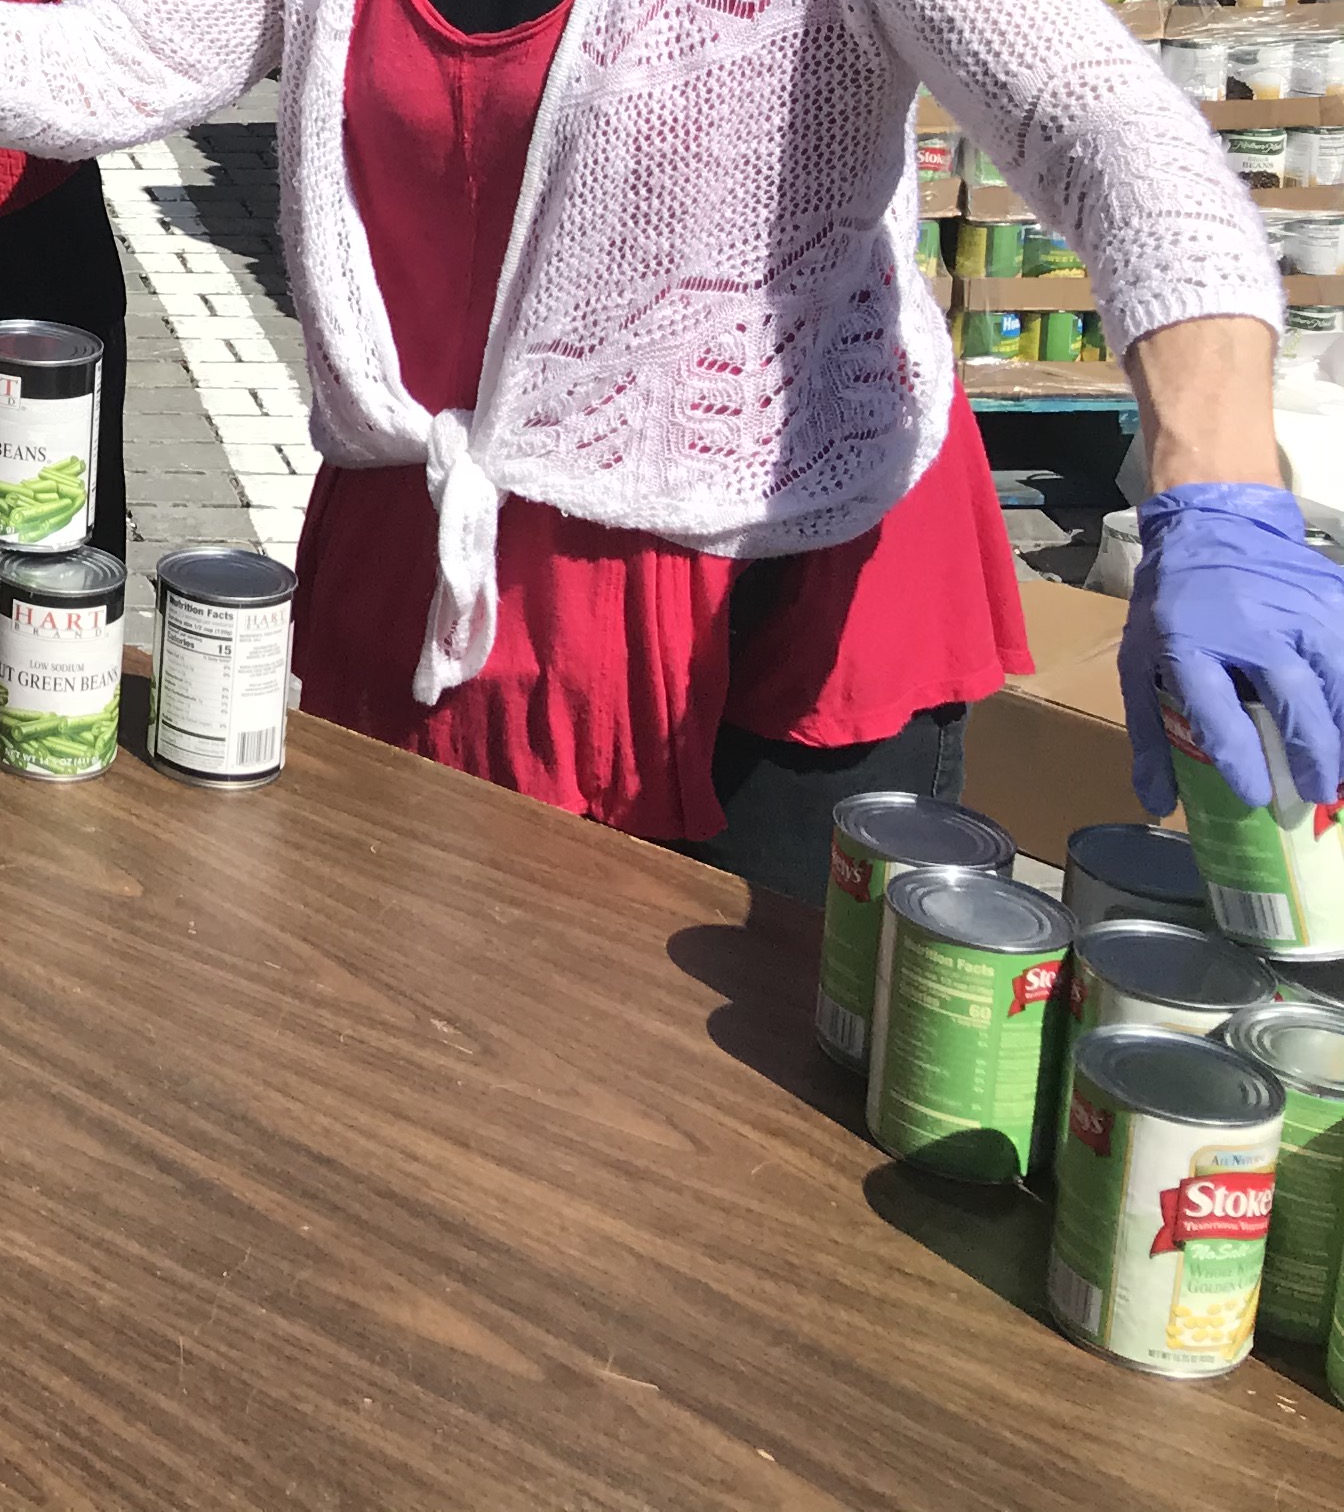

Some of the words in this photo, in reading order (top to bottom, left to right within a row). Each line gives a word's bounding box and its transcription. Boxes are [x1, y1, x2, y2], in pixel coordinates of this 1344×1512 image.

[1242, 161, 1274, 169] BEANS
[169, 595, 205, 617] Nutrition
[206, 608, 234, 621] Facts
[14, 603, 105, 631] HART
[247, 610, 286, 626] HART
[14, 622, 102, 639] BRAND
[166, 630, 195, 650] Calories
[217, 644, 232, 656] 15
[29, 659, 50, 671] LOW
[50, 660, 85, 672] SODIUM
[17, 670, 76, 694] GREEN
[80, 665, 119, 693] BEANS
[23, 752, 36, 764] WT
[60, 757, 73, 766] OZ
[956, 957, 995, 976] Facts
[968, 1003, 992, 1020] 60
